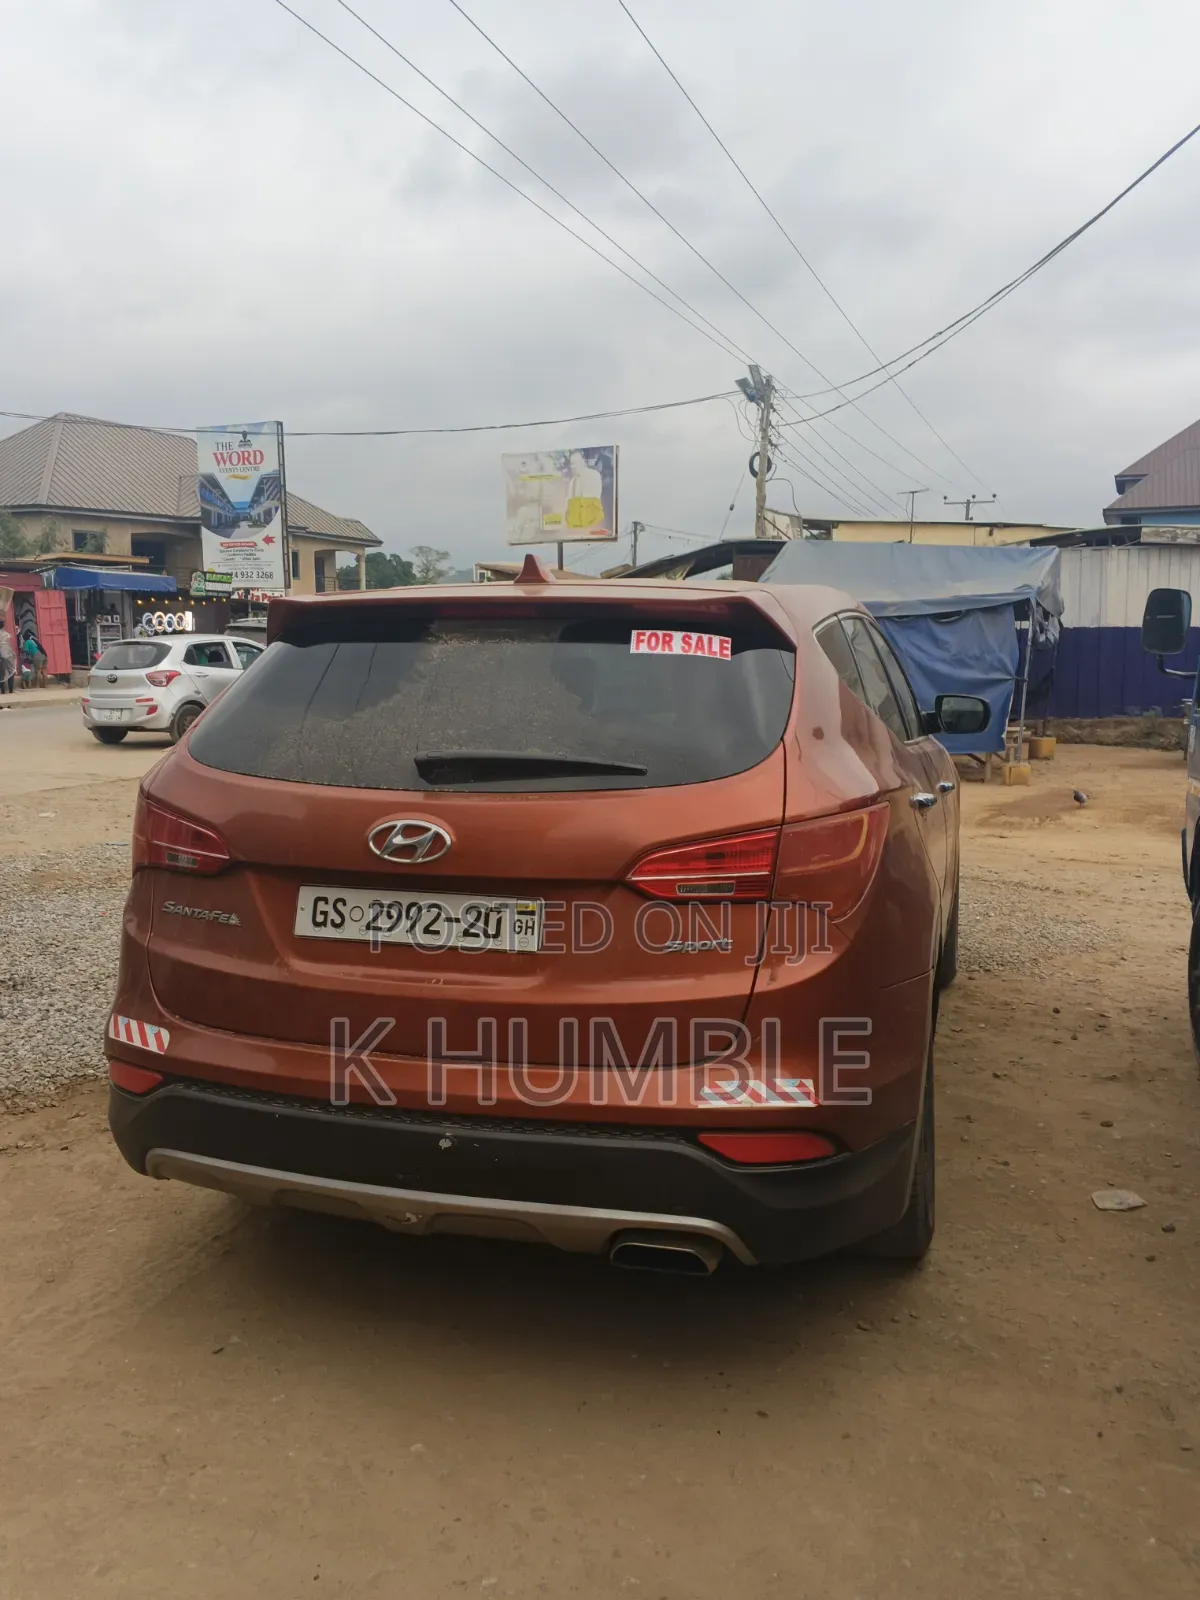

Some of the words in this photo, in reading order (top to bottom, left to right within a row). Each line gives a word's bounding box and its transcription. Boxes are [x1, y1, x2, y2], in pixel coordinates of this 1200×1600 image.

[215, 441, 234, 451] THE
[212, 449, 265, 467] WORD
[240, 570, 254, 579] 932
[256, 570, 274, 579] 3268
[634, 631, 674, 652] FOR
[680, 633, 730, 659] SALE
[311, 896, 347, 929] GS
[365, 900, 504, 938] 2992-20
[513, 918, 536, 936] GH
[662, 938, 733, 953] Sport
